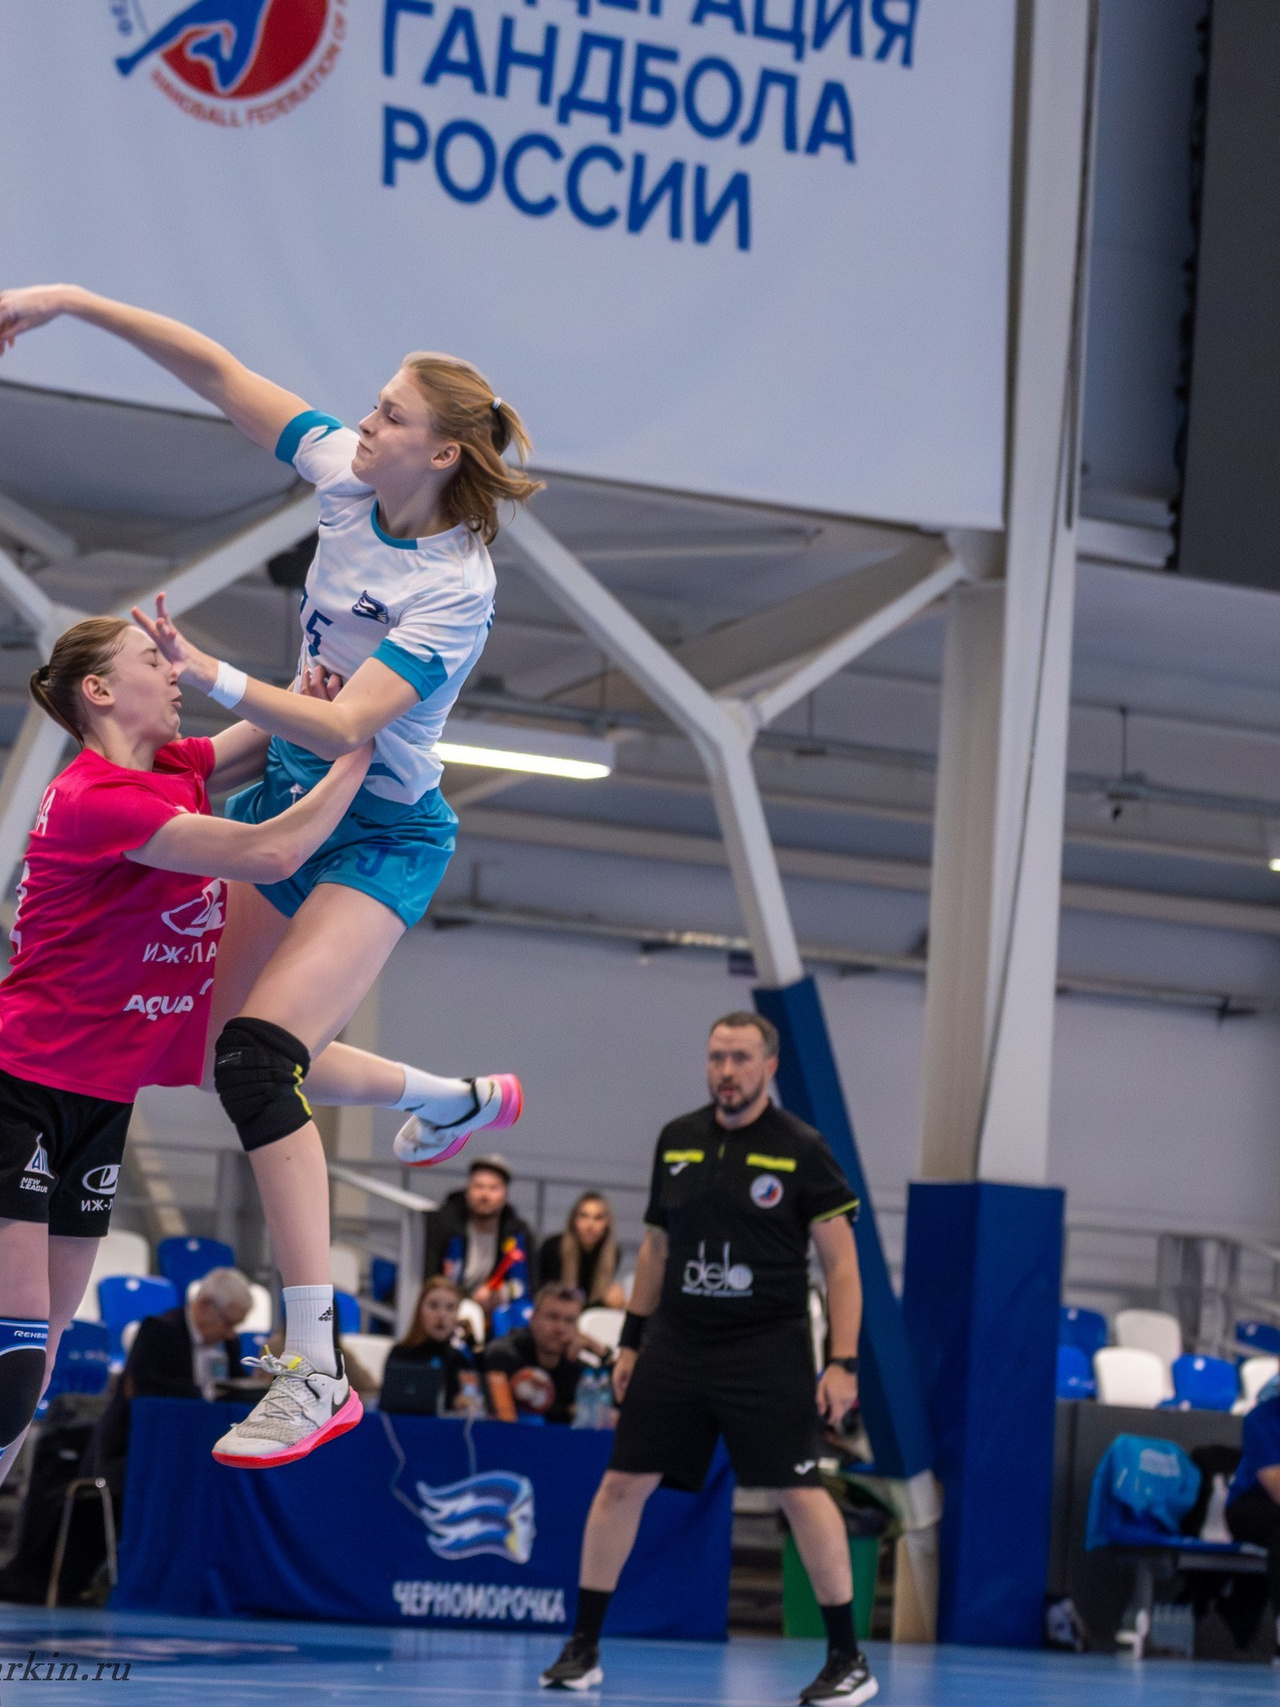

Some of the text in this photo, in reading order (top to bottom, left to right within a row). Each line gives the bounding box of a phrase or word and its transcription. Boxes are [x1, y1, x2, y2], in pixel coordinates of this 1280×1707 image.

[382, 0, 857, 165] ГАНДБОЛА
[382, 103, 752, 252] РОССИИ
[123, 994, 194, 1021] AQUA
[21, 1176, 41, 1188] NEW
[392, 1580, 567, 1624] ЧЕРНОМОРОЧКА
